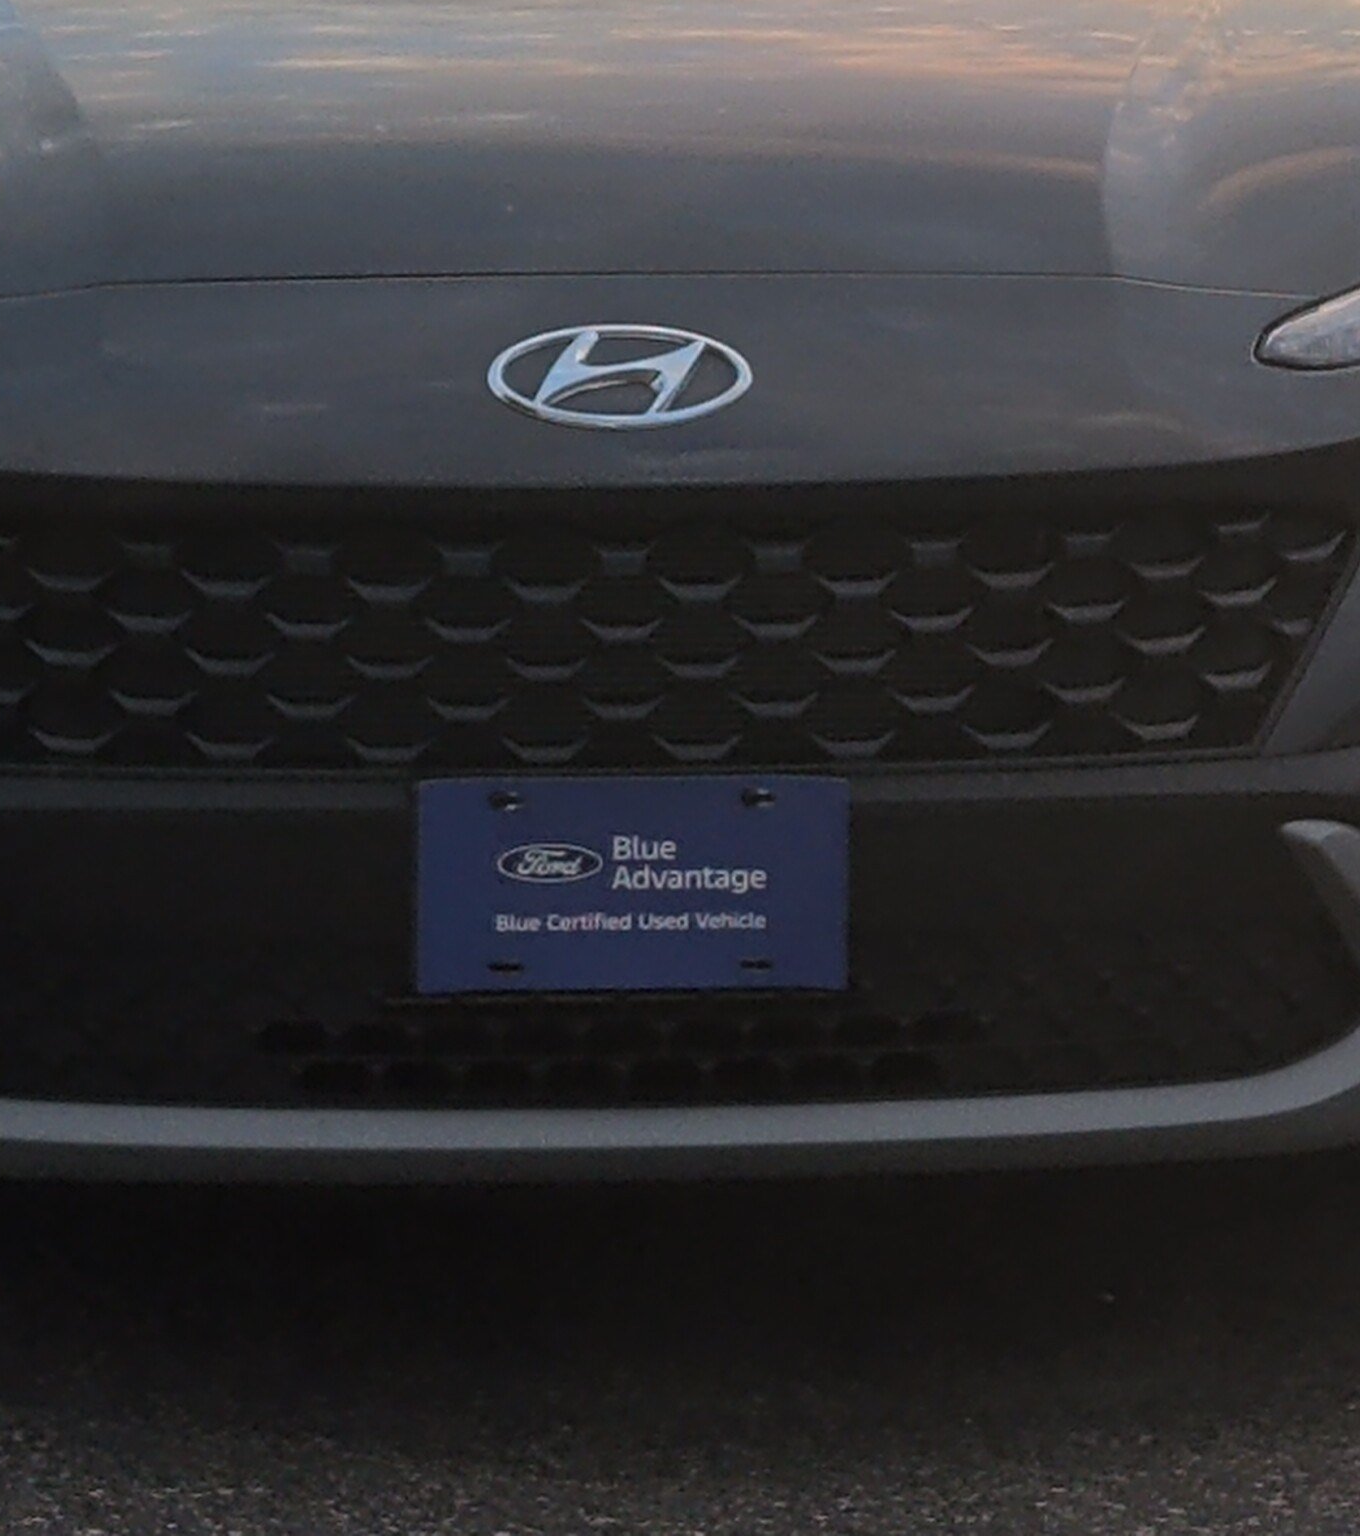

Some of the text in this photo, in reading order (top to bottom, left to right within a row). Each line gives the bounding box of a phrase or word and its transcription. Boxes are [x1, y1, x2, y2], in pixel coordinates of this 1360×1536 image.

[611, 835, 677, 861] Blue
[517, 848, 584, 876] Ford
[611, 864, 768, 894] Advantage
[495, 911, 767, 932] Blue Certified Used Vehicle
